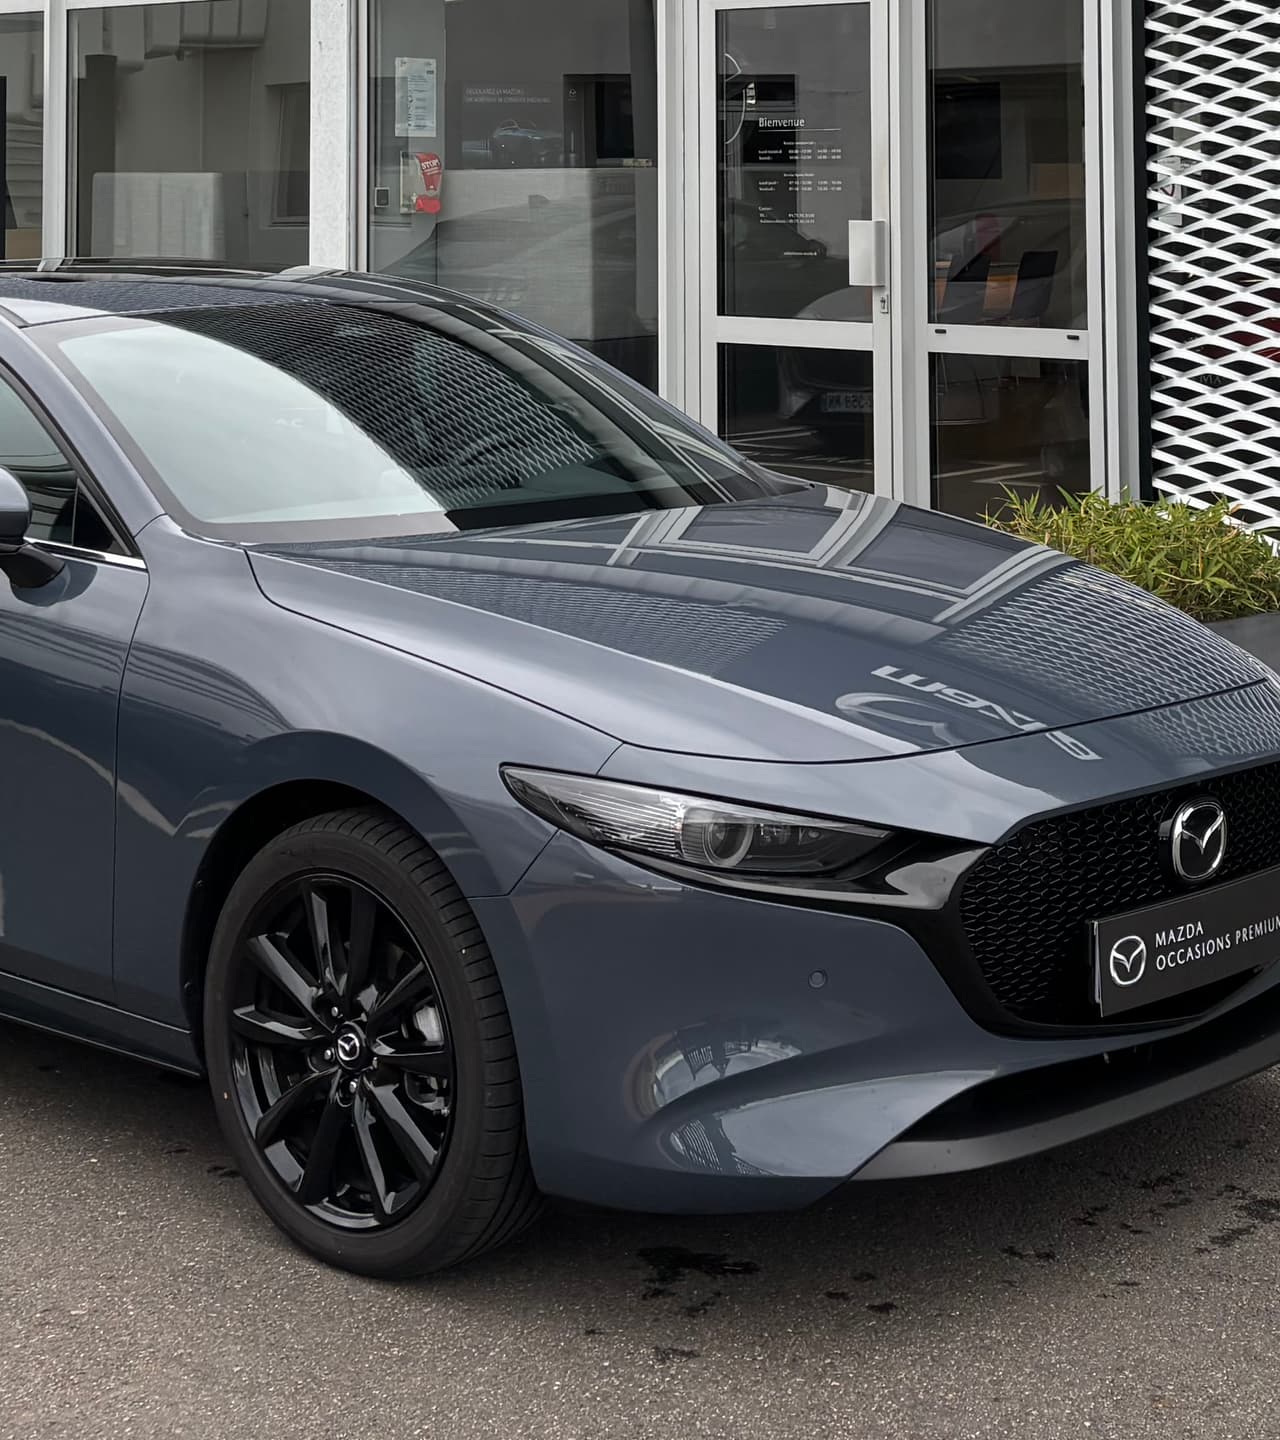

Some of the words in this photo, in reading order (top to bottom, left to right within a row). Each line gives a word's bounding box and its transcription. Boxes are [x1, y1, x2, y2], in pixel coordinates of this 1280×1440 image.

[759, 117, 805, 128] Bienvenue
[1155, 921, 1204, 948] MAZDA
[1156, 933, 1231, 971] OCCASIONS
